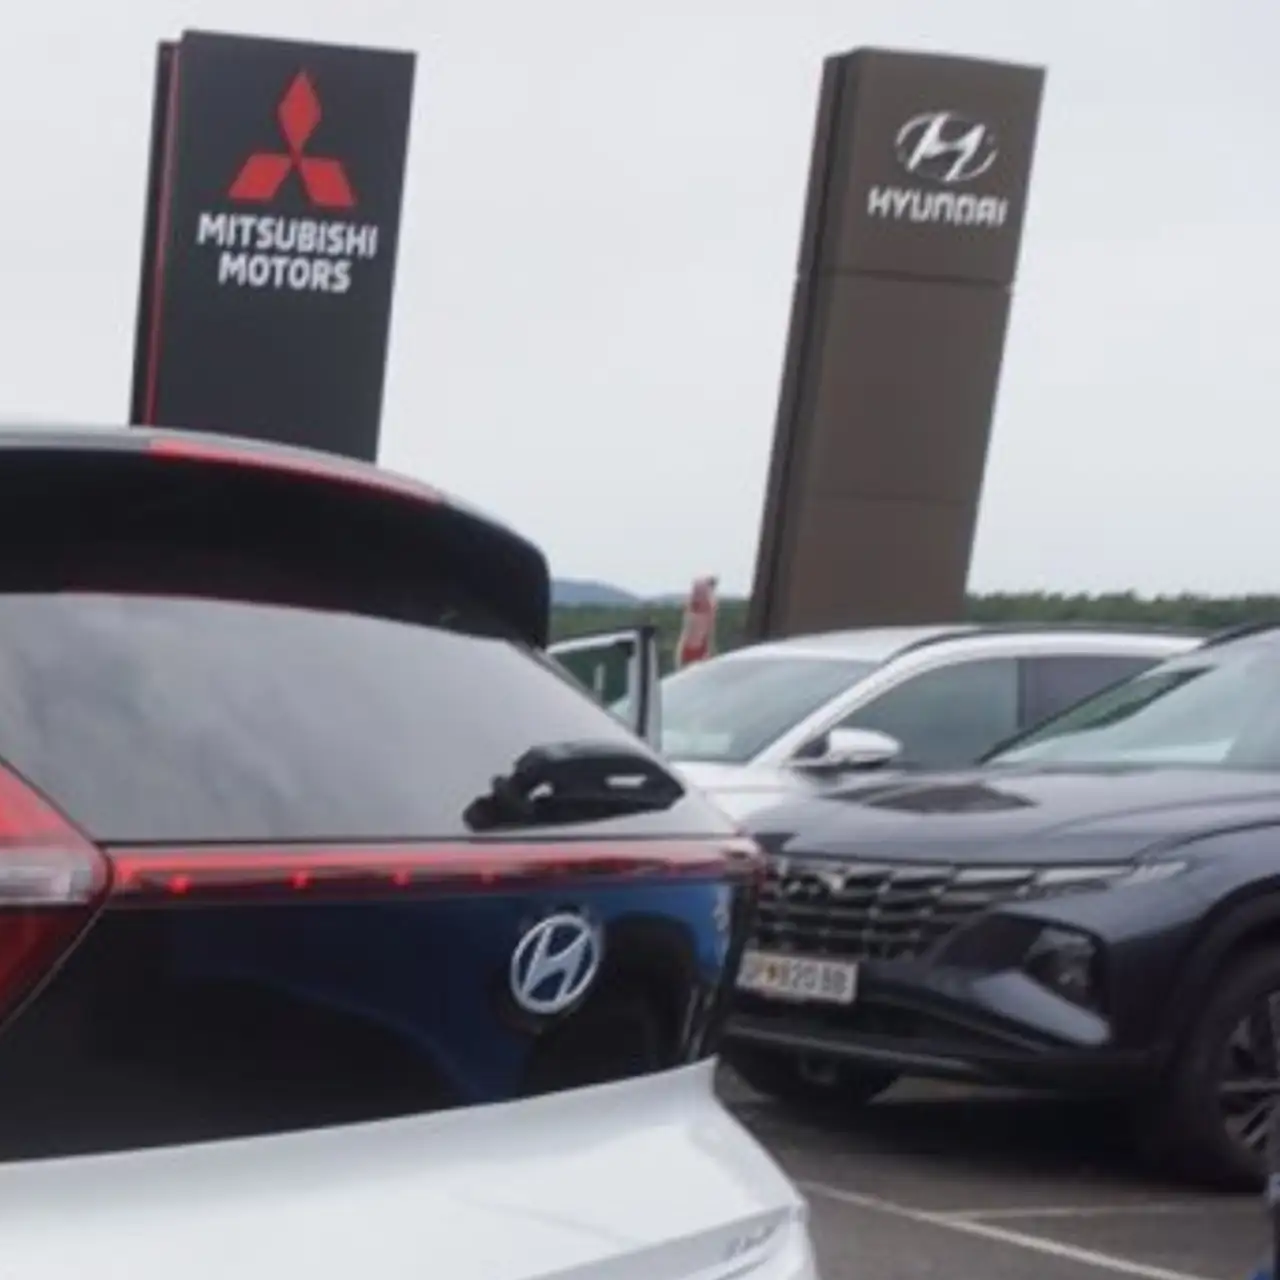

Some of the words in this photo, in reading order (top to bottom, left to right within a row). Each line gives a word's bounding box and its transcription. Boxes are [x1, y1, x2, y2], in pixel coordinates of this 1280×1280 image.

[866, 184, 1009, 228] HYUNDAI
[197, 212, 379, 259] MITSUBISHI
[218, 251, 352, 294] MOTORS
